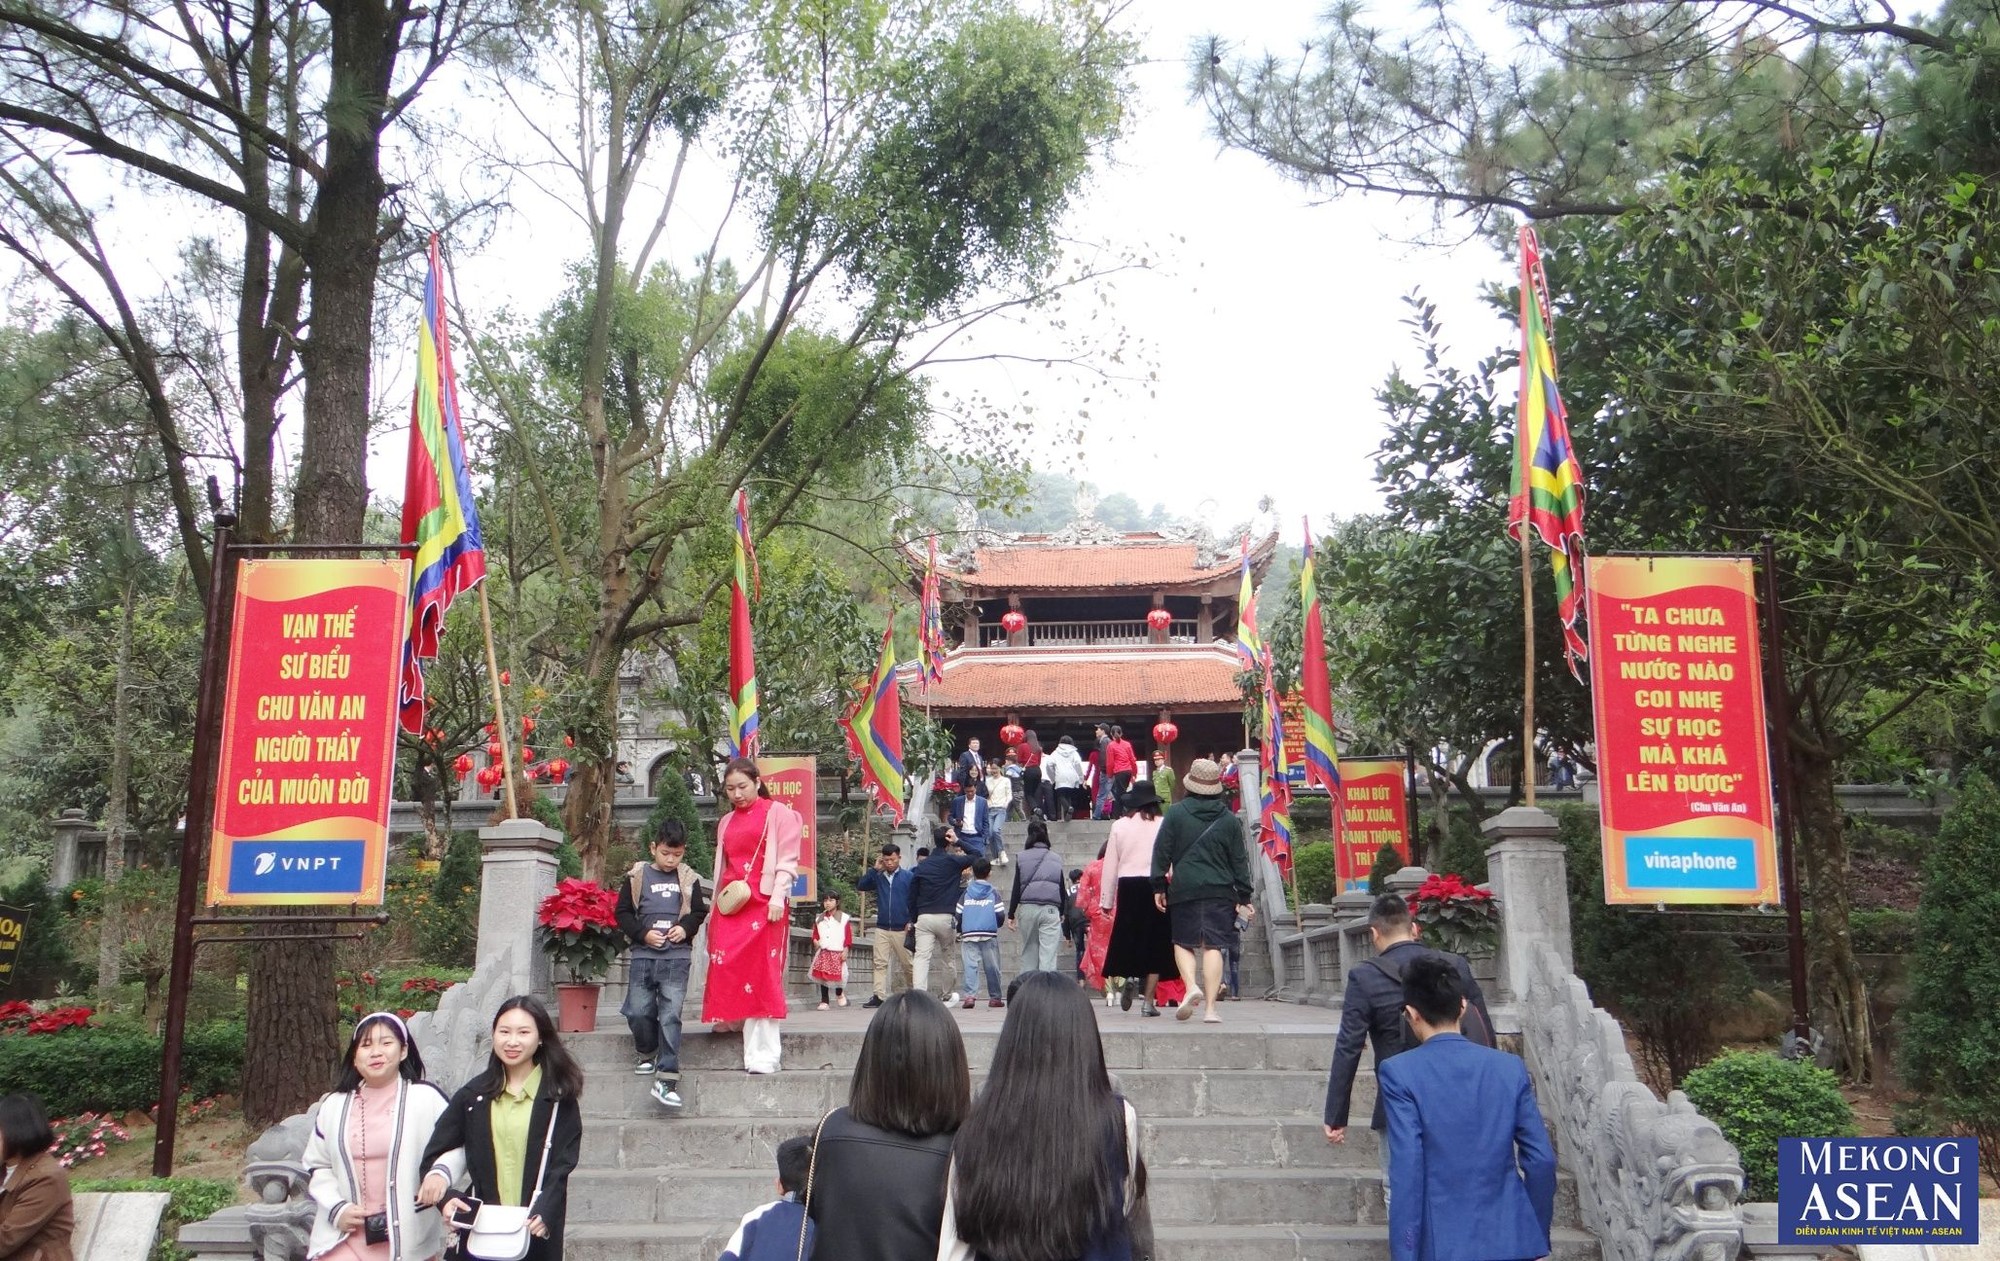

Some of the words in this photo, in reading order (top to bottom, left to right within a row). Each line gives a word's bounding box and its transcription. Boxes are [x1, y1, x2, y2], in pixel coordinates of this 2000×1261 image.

[283, 614, 318, 644] VẠN
[323, 604, 358, 638] THẾ
[1665, 606, 1725, 626] CHƯA
[1612, 630, 1672, 652] TỪNG
[1677, 635, 1737, 654] NGHE
[280, 652, 308, 679] SƯ
[309, 644, 351, 679] BIỂU
[1620, 657, 1681, 680] NƯỚC
[1687, 660, 1734, 681] NÀO
[258, 695, 295, 720] CHU
[299, 690, 335, 720] VĂN
[338, 695, 366, 720] AN
[1635, 690, 1672, 708] COI
[1679, 690, 1723, 713] NHẸ
[1640, 716, 1673, 740] SỰ
[1677, 718, 1722, 740] HỌC
[255, 730, 312, 762] NGƯỜI
[316, 728, 361, 762] THẦY
[1639, 743, 1676, 764] MÀ
[1682, 744, 1727, 765] KHÁ
[238, 768, 274, 805] CỦA
[279, 773, 334, 804] MUÔN
[338, 771, 370, 804] ĐỜI
[783, 781, 802, 798] HỌC
[1346, 787, 1370, 801] KHAI
[1371, 784, 1390, 801] BÚT
[1626, 770, 1668, 792] LÊN
[1690, 801, 1711, 813] (Chu
[1712, 802, 1730, 813] Văn
[1731, 802, 1747, 814] An)
[1369, 827, 1402, 844] THÔNG
[281, 857, 342, 870] VNPT
[1644, 851, 1737, 874] vinaphone
[0, 917, 22, 941] OA
